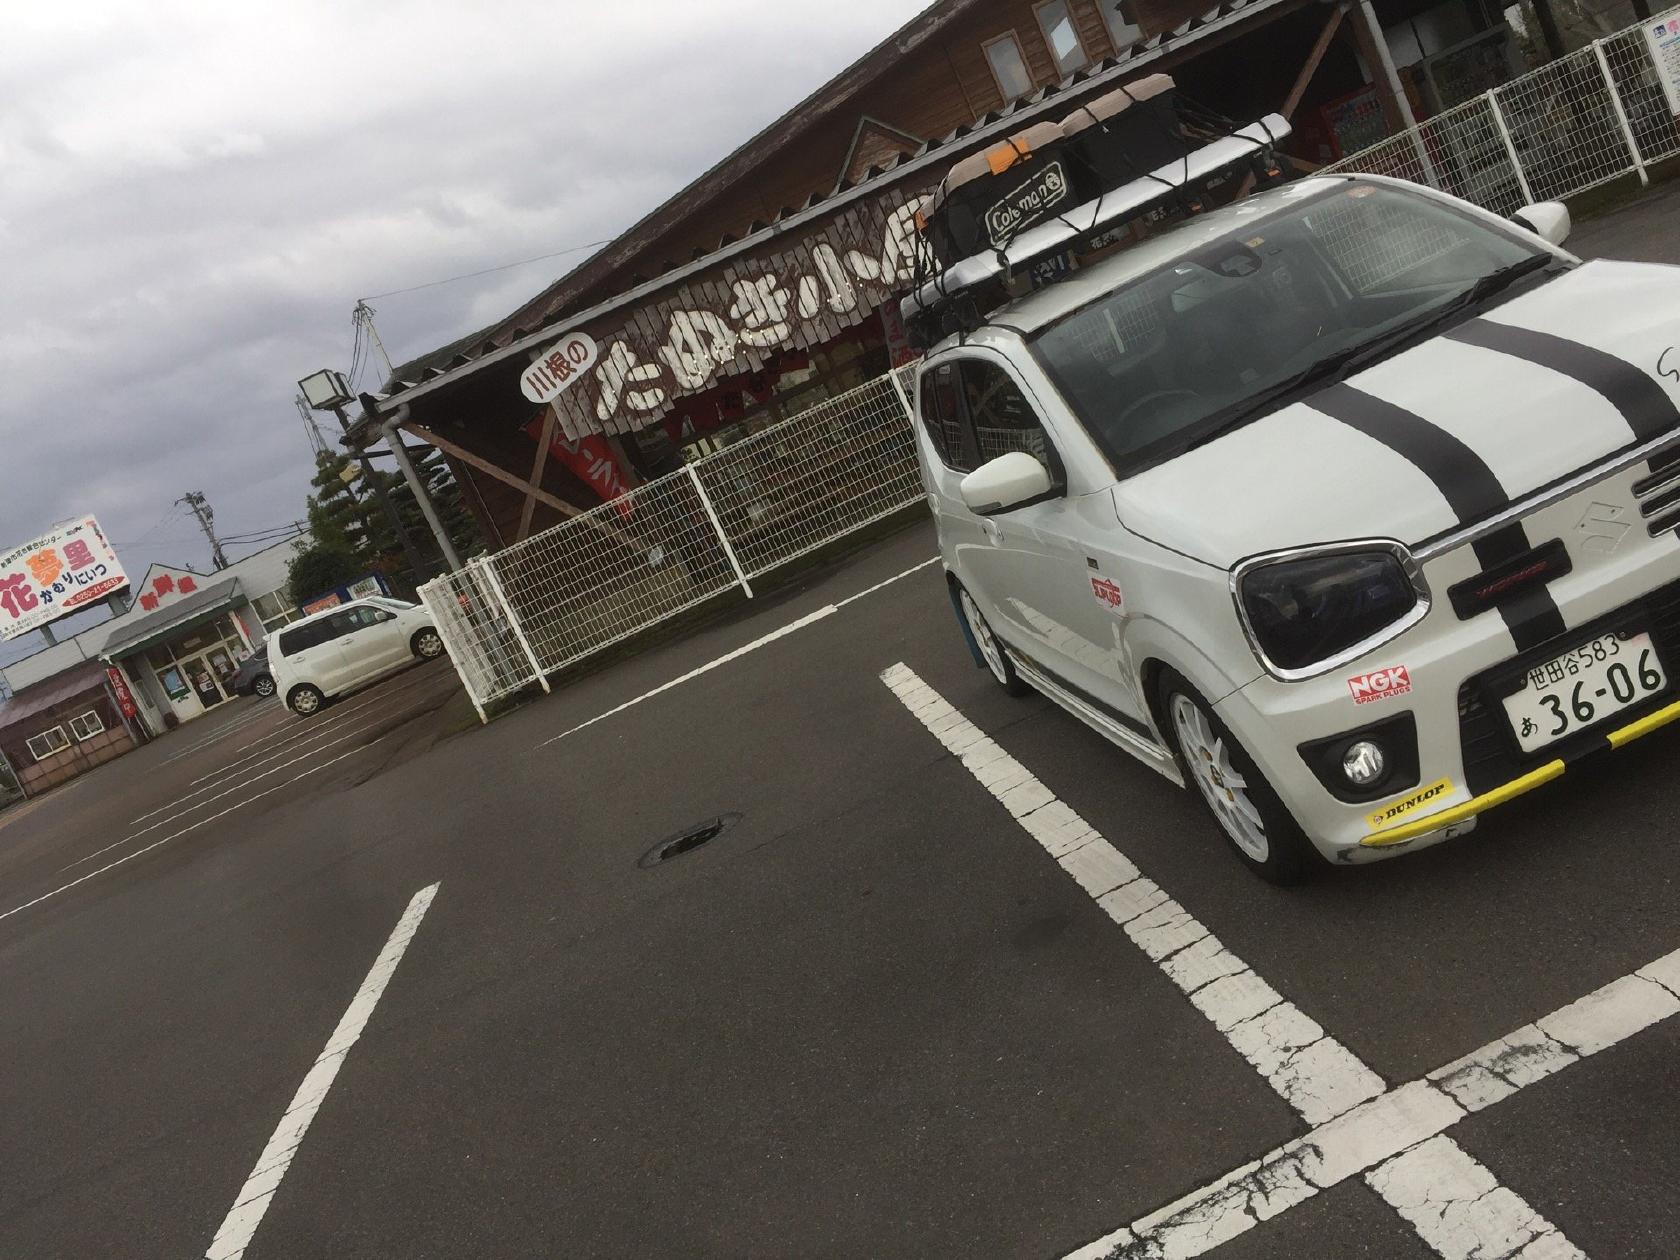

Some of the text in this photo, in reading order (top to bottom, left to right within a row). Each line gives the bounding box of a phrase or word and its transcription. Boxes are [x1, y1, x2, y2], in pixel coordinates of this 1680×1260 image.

[992, 184, 1047, 232] Coleman
[526, 339, 589, 400] 川根の
[1349, 666, 1409, 699] NGK
[1355, 685, 1411, 705] SPARK PLUGS
[1520, 648, 1662, 738] あ 36-06
[1385, 783, 1445, 820] DUNLOP
